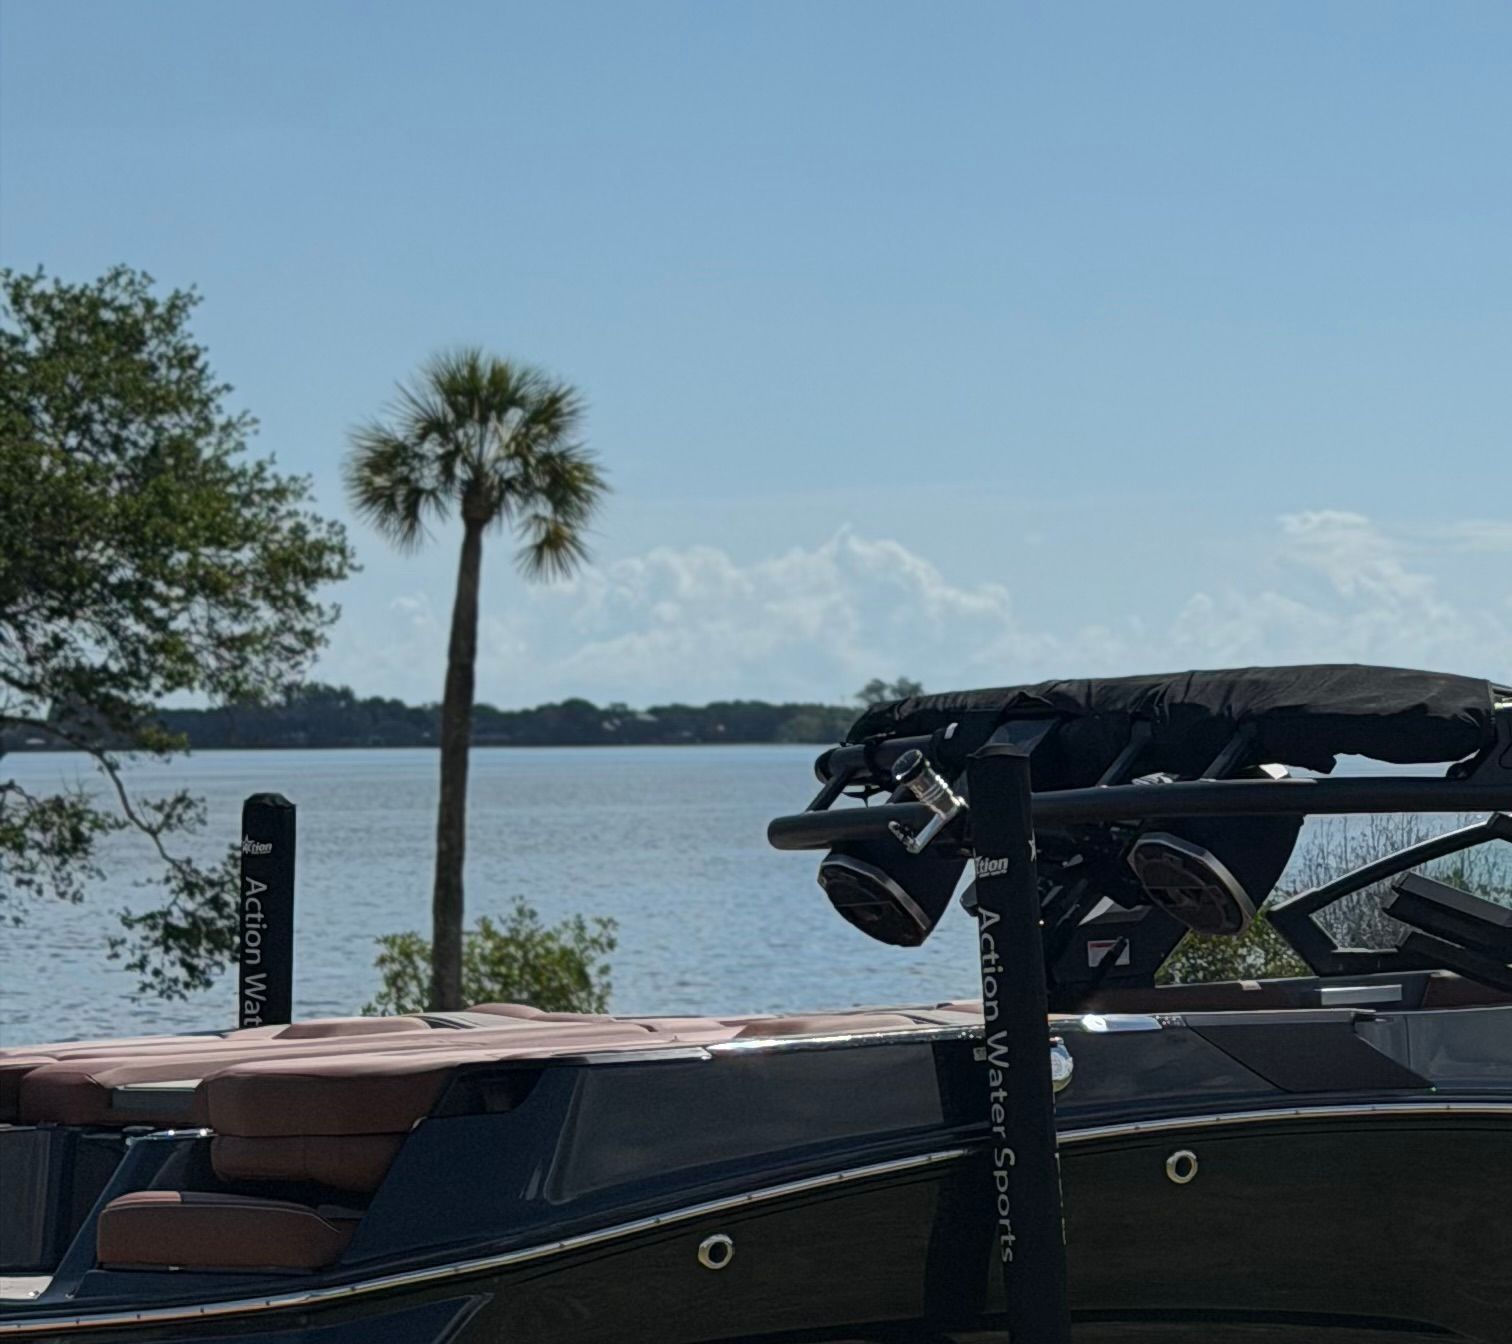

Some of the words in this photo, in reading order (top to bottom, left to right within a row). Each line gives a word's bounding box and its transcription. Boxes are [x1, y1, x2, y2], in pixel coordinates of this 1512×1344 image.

[245, 876, 269, 965] Action
[978, 907, 1004, 1022] Action
[987, 1030, 1010, 1139] Water
[993, 1147, 1017, 1263] Sports
